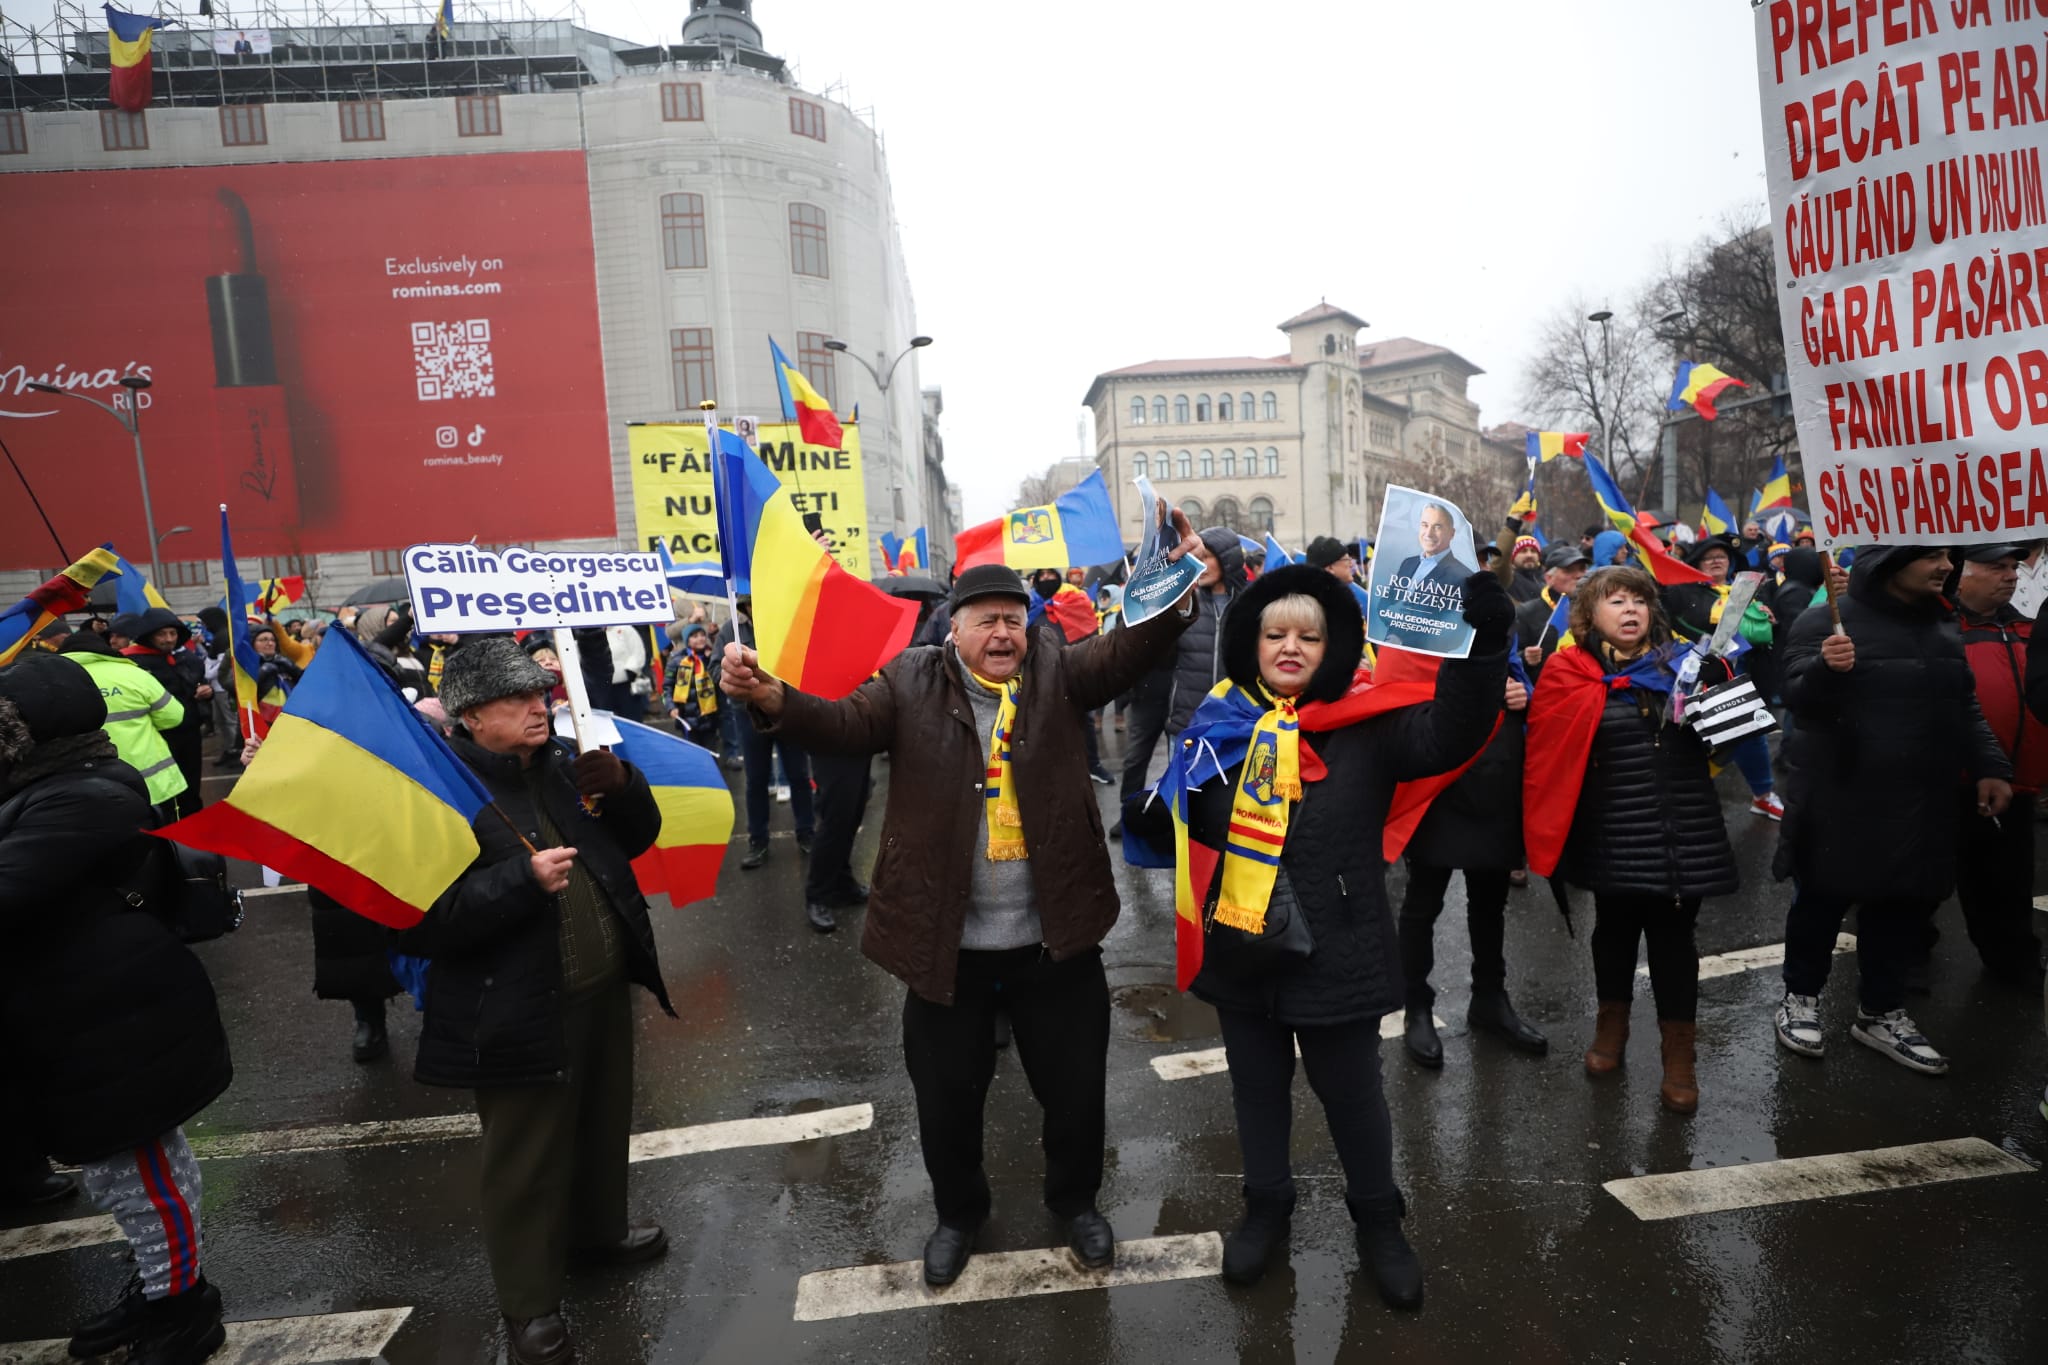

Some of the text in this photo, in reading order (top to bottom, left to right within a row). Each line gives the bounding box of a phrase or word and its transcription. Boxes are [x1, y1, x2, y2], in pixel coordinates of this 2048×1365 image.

[1770, 0, 1939, 85] PREFER
[1785, 32, 2048, 181] DECÂT PE AR
[1786, 147, 2047, 279] CĂUTÂND UN DRUM
[385, 254, 503, 277] Exclusively on
[392, 280, 501, 298] rominas.com
[1801, 279, 1899, 367] GARA
[112, 392, 152, 410] RD
[1825, 349, 2048, 451] FAMILII OB
[424, 453, 503, 467] rominas_beauty
[643, 448, 711, 473] “FĂ
[665, 496, 712, 516] NU
[1820, 448, 2048, 541] SĂ-ȘI PĂRĂSEA
[412, 550, 659, 578] Călin Georgescu
[1375, 584, 1464, 612] SE TREZEȘTE
[1388, 574, 1462, 599] ROMÂNIA
[420, 582, 668, 626] Președinte!
[1379, 609, 1457, 629] CĂLIN GEORGESCU
[1713, 697, 1747, 713] SEPHORA
[1237, 808, 1282, 828] ROMANIA
